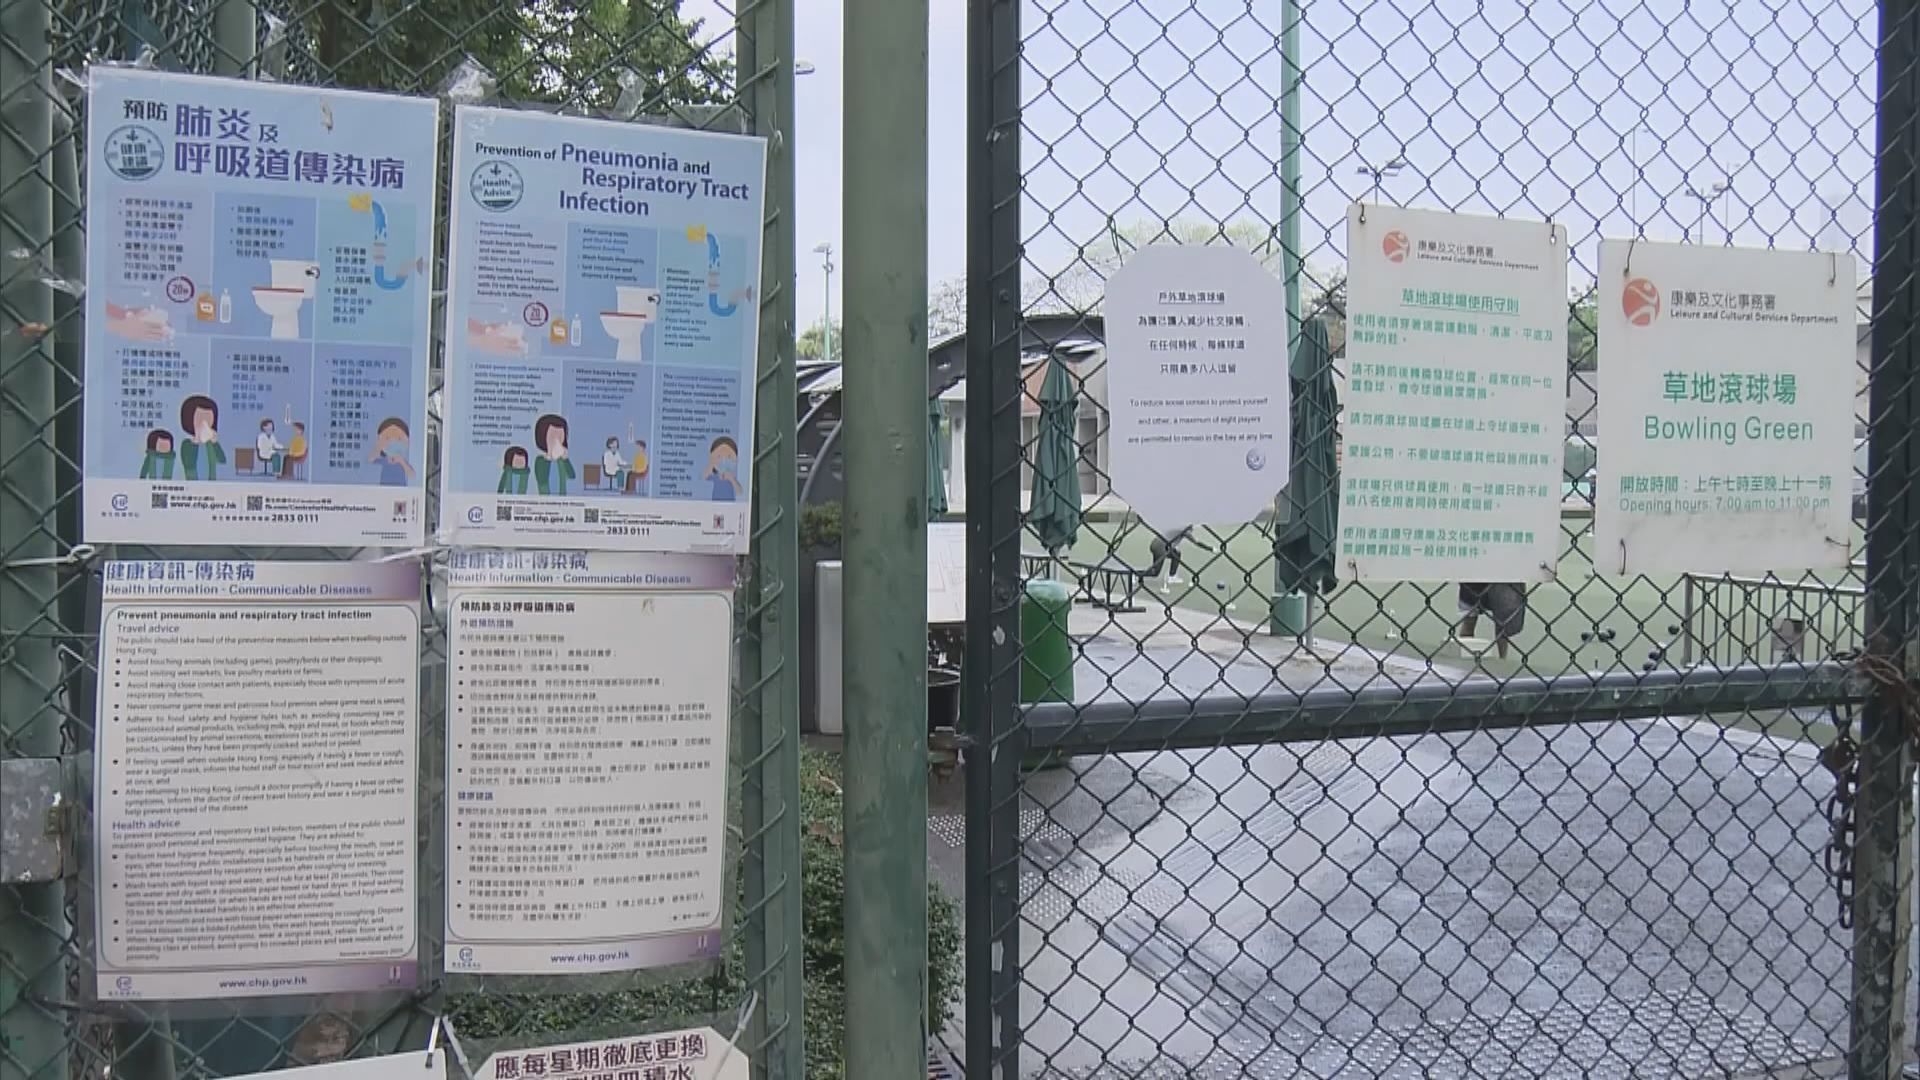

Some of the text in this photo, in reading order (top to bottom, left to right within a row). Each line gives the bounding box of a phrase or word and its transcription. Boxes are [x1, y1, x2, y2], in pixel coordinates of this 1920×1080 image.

[123, 100, 168, 121] 預防
[475, 142, 711, 176] Prevention of Pneumonia and
[174, 142, 405, 189] 呼吸道傳染病
[482, 178, 511, 188] Health
[582, 168, 749, 200] Respiratory Tract
[482, 187, 512, 198] Advice
[560, 190, 649, 216] Infection
[1418, 240, 1494, 258] 康樂及文化事務署
[1418, 252, 1438, 260] Leisure
[1454, 255, 1477, 264] Cultural
[1479, 258, 1502, 266] Services
[1505, 260, 1539, 271] Department
[1402, 288, 1519, 313] 草地滾球場使用守則
[1671, 290, 1776, 310] 康樂及文化事務署
[530, 307, 541, 317] 20
[1671, 310, 1838, 325] Leisure and Cultural Services Department
[1663, 371, 1797, 405] 草地滾球場
[1219, 398, 1241, 407] protect
[1243, 398, 1268, 406] yourself
[1221, 416, 1236, 424] eight
[1238, 416, 1261, 424] players
[1644, 416, 1813, 445] Bowling Green
[1141, 435, 1172, 443] permitted
[1225, 433, 1236, 441] bay
[170, 500, 236, 510] www.chp.gov.hk
[1620, 499, 1671, 514] Opening
[1744, 500, 1762, 509] am
[1765, 497, 1776, 509] to
[1813, 499, 1830, 511] pm
[271, 513, 295, 523] 2833
[298, 513, 319, 523] 0111
[514, 515, 575, 523] www.chp.gov.hk
[606, 526, 628, 535] 2833
[630, 527, 650, 536] 0111
[106, 561, 255, 580] 健康資訊-傳染病
[450, 574, 691, 583] Health Information Communicable Diseases
[105, 585, 372, 594] Health Information Communicable Diseases
[460, 601, 575, 613] 預防肺炎及呼吸道傳染病
[118, 610, 372, 621] Prevent pneumonia and respiratory tract infection
[118, 624, 180, 632] Travel advice
[116, 647, 135, 655] Hong
[151, 657, 182, 666] touching
[112, 819, 181, 829] Health advice
[550, 951, 630, 963] www.chp.gov.hk
[219, 975, 308, 990] www.chp.gov.hk
[495, 1034, 704, 1079] 應每星期徹底更換
